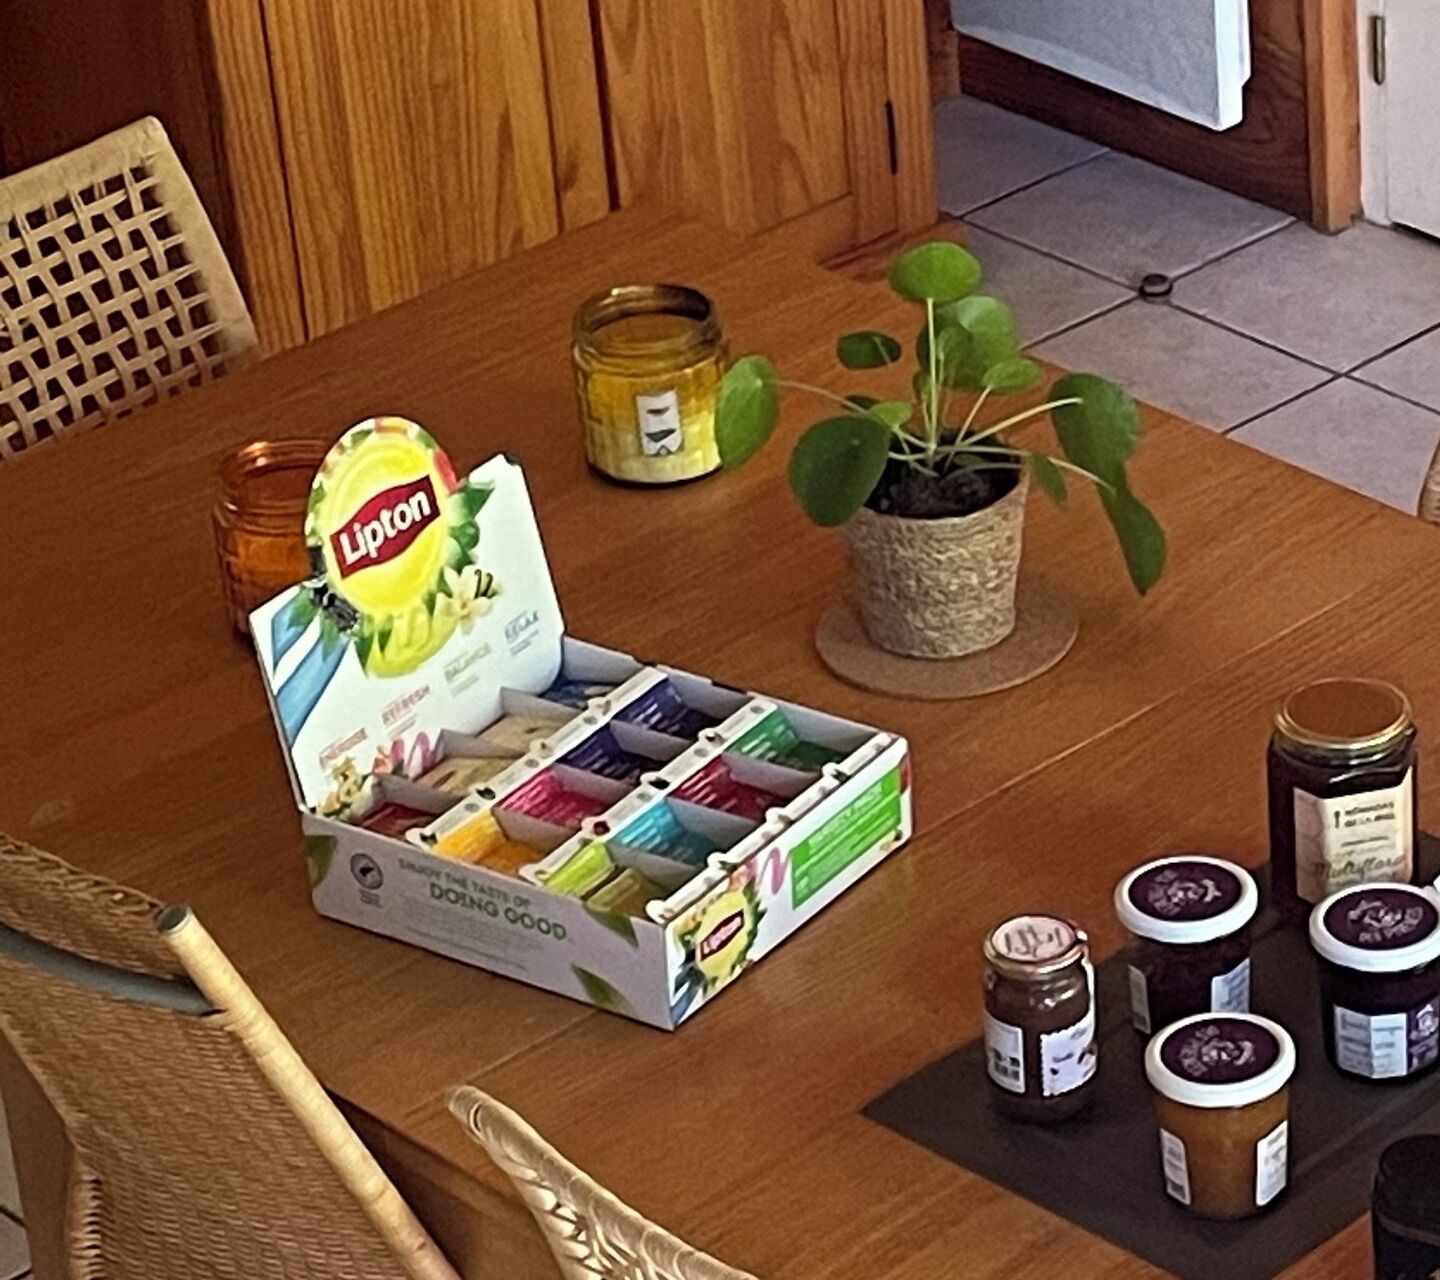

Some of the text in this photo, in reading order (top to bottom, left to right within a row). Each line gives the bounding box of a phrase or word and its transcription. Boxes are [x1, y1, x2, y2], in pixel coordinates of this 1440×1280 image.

[338, 490, 431, 565] Lipton
[429, 881, 500, 918] DOING
[504, 906, 568, 941] GOOD
[445, 871, 469, 891] THE
[471, 880, 510, 903] TASTE
[513, 894, 531, 908] OF
